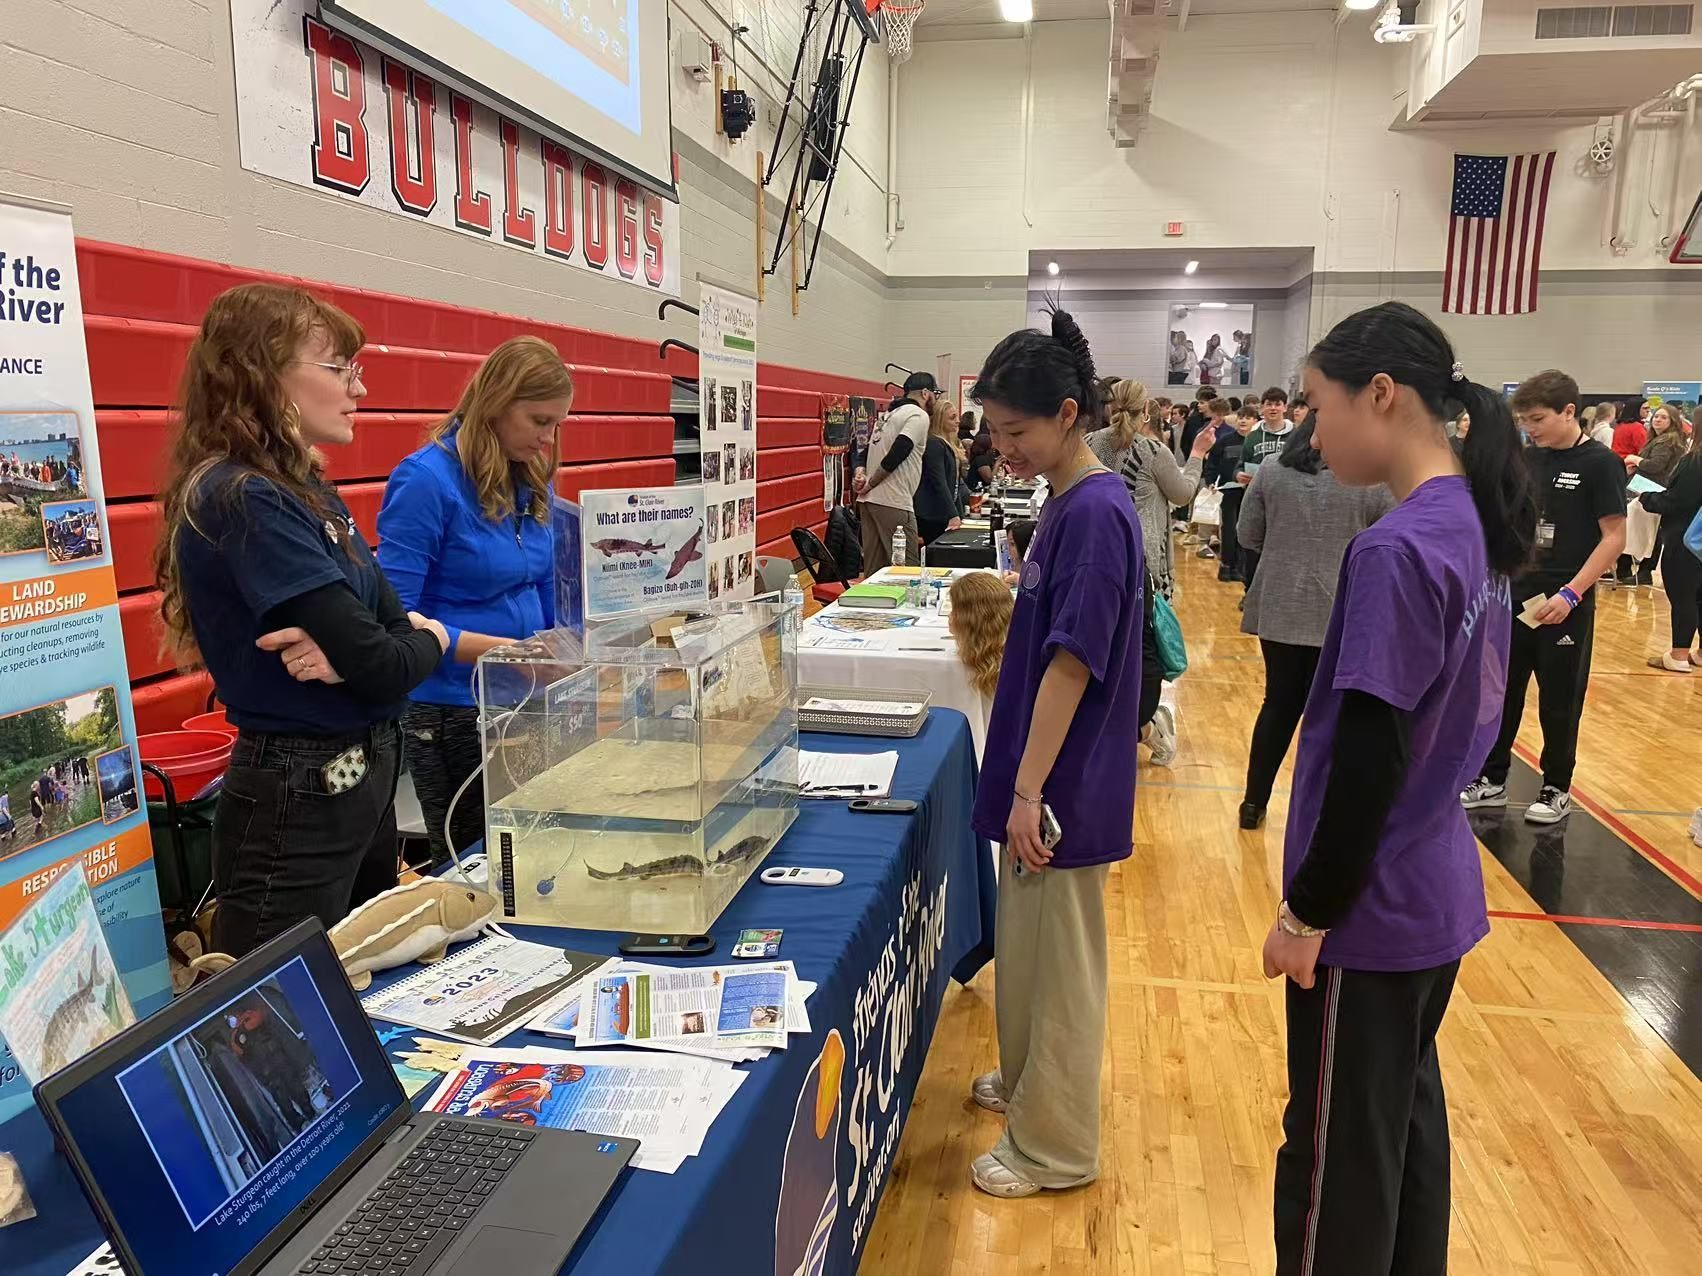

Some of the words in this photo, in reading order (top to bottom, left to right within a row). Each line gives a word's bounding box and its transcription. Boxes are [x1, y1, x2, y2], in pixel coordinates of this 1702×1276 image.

[302, 13, 664, 288] BULLDOGS
[12, 256, 60, 290] the
[596, 512, 620, 526] What
[622, 512, 636, 524] are
[638, 508, 659, 522] their
[661, 506, 694, 520] names?
[13, 580, 56, 602] LAND
[1, 631, 13, 643] for
[14, 629, 30, 640] our
[30, 622, 60, 636] natural
[61, 616, 95, 630] resources
[95, 612, 104, 624] by
[26, 638, 64, 653] cleanups,
[65, 628, 99, 643] removing
[9, 656, 40, 672] species
[40, 654, 47, 664] &
[48, 646, 80, 662] tracking
[81, 640, 106, 653] wildlife
[119, 876, 142, 894] nature
[442, 967, 499, 996] 2023
[847, 1059, 875, 1208] St.
[214, 1207, 233, 1226] Lake
[231, 1180, 264, 1213] Sturgeon
[262, 1159, 285, 1187] caught
[283, 1153, 291, 1165] in
[290, 1144, 302, 1163] the
[299, 1123, 323, 1152] Detroit
[320, 1113, 338, 1135] River,
[236, 1211, 251, 1227] 240
[249, 1200, 264, 1216] lbs,
[264, 1182, 281, 1200] feet
[278, 1169, 297, 1190] long,
[294, 1157, 310, 1173] over
[307, 1146, 320, 1161] 100
[318, 1134, 336, 1153] years
